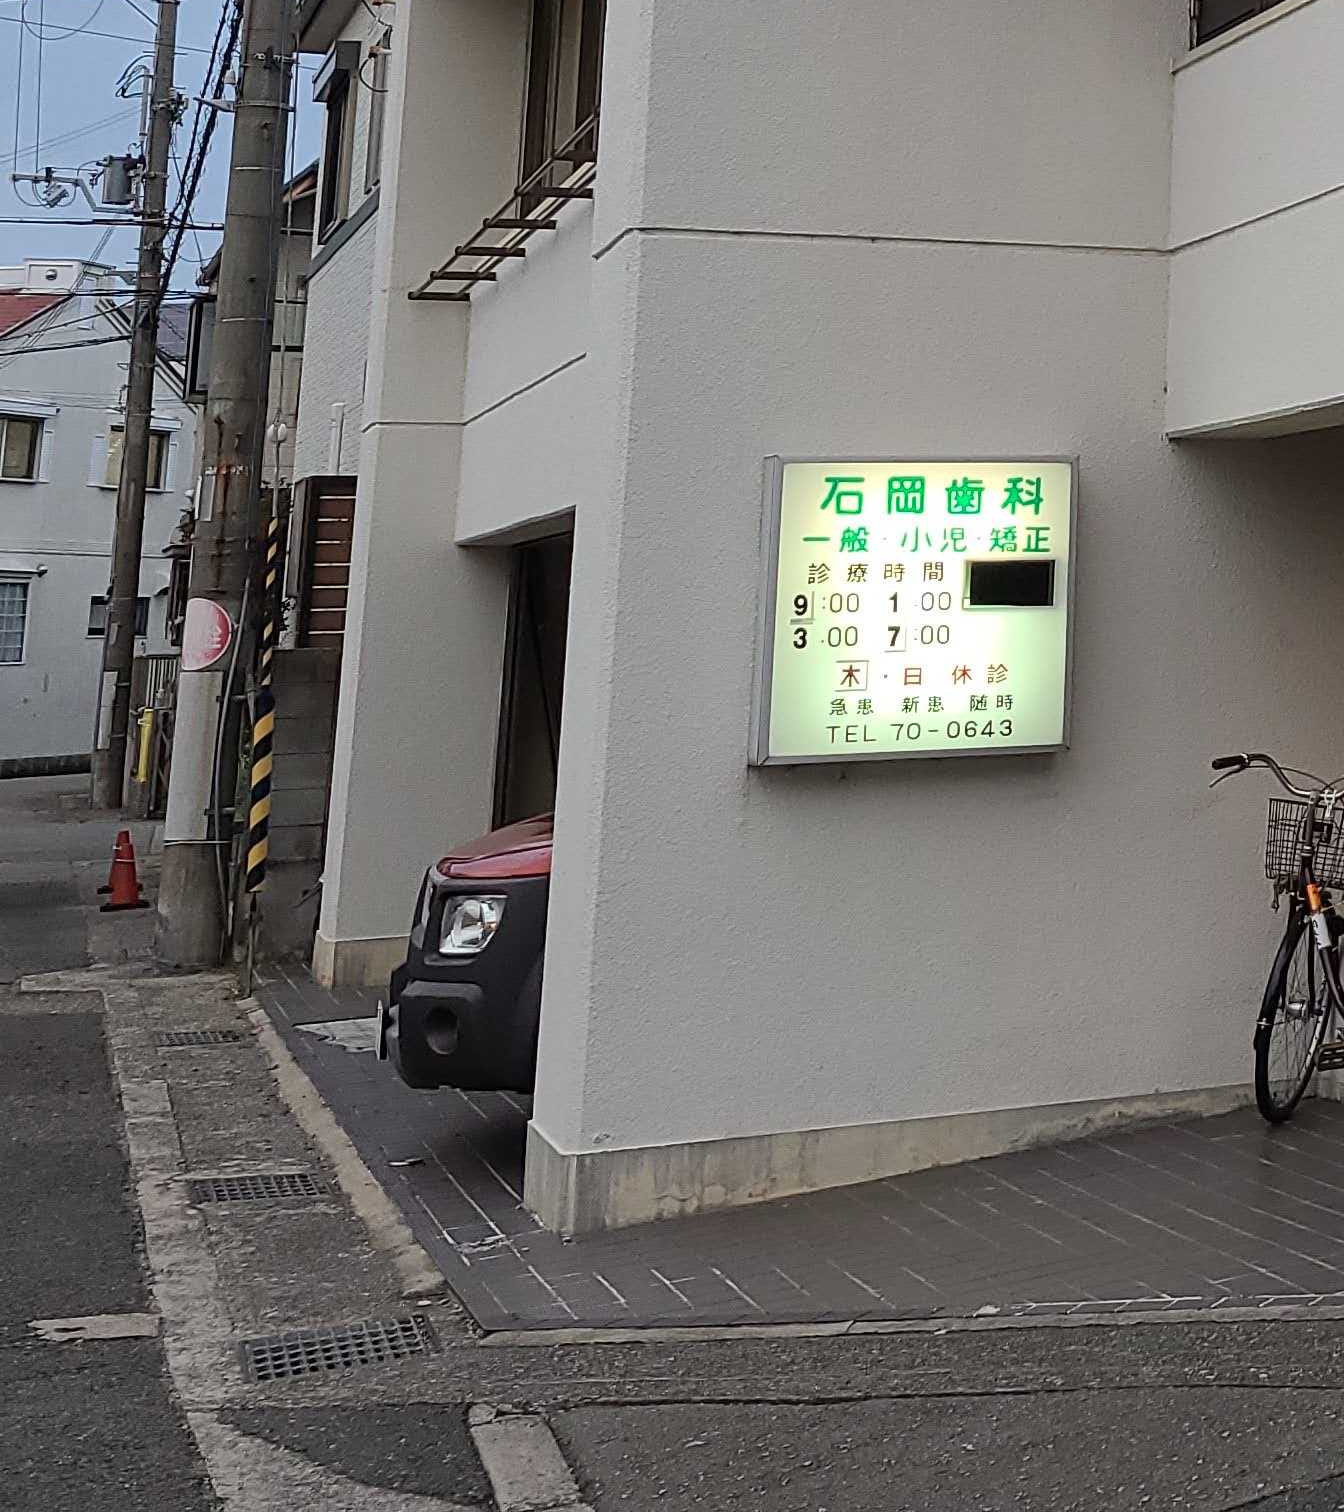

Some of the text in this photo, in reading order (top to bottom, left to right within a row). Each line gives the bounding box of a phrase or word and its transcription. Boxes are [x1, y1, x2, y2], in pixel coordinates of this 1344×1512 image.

[820, 475, 1044, 516] 石岡歯科
[807, 561, 945, 585] 診療時間
[826, 719, 1013, 744] TEL 70-0643
